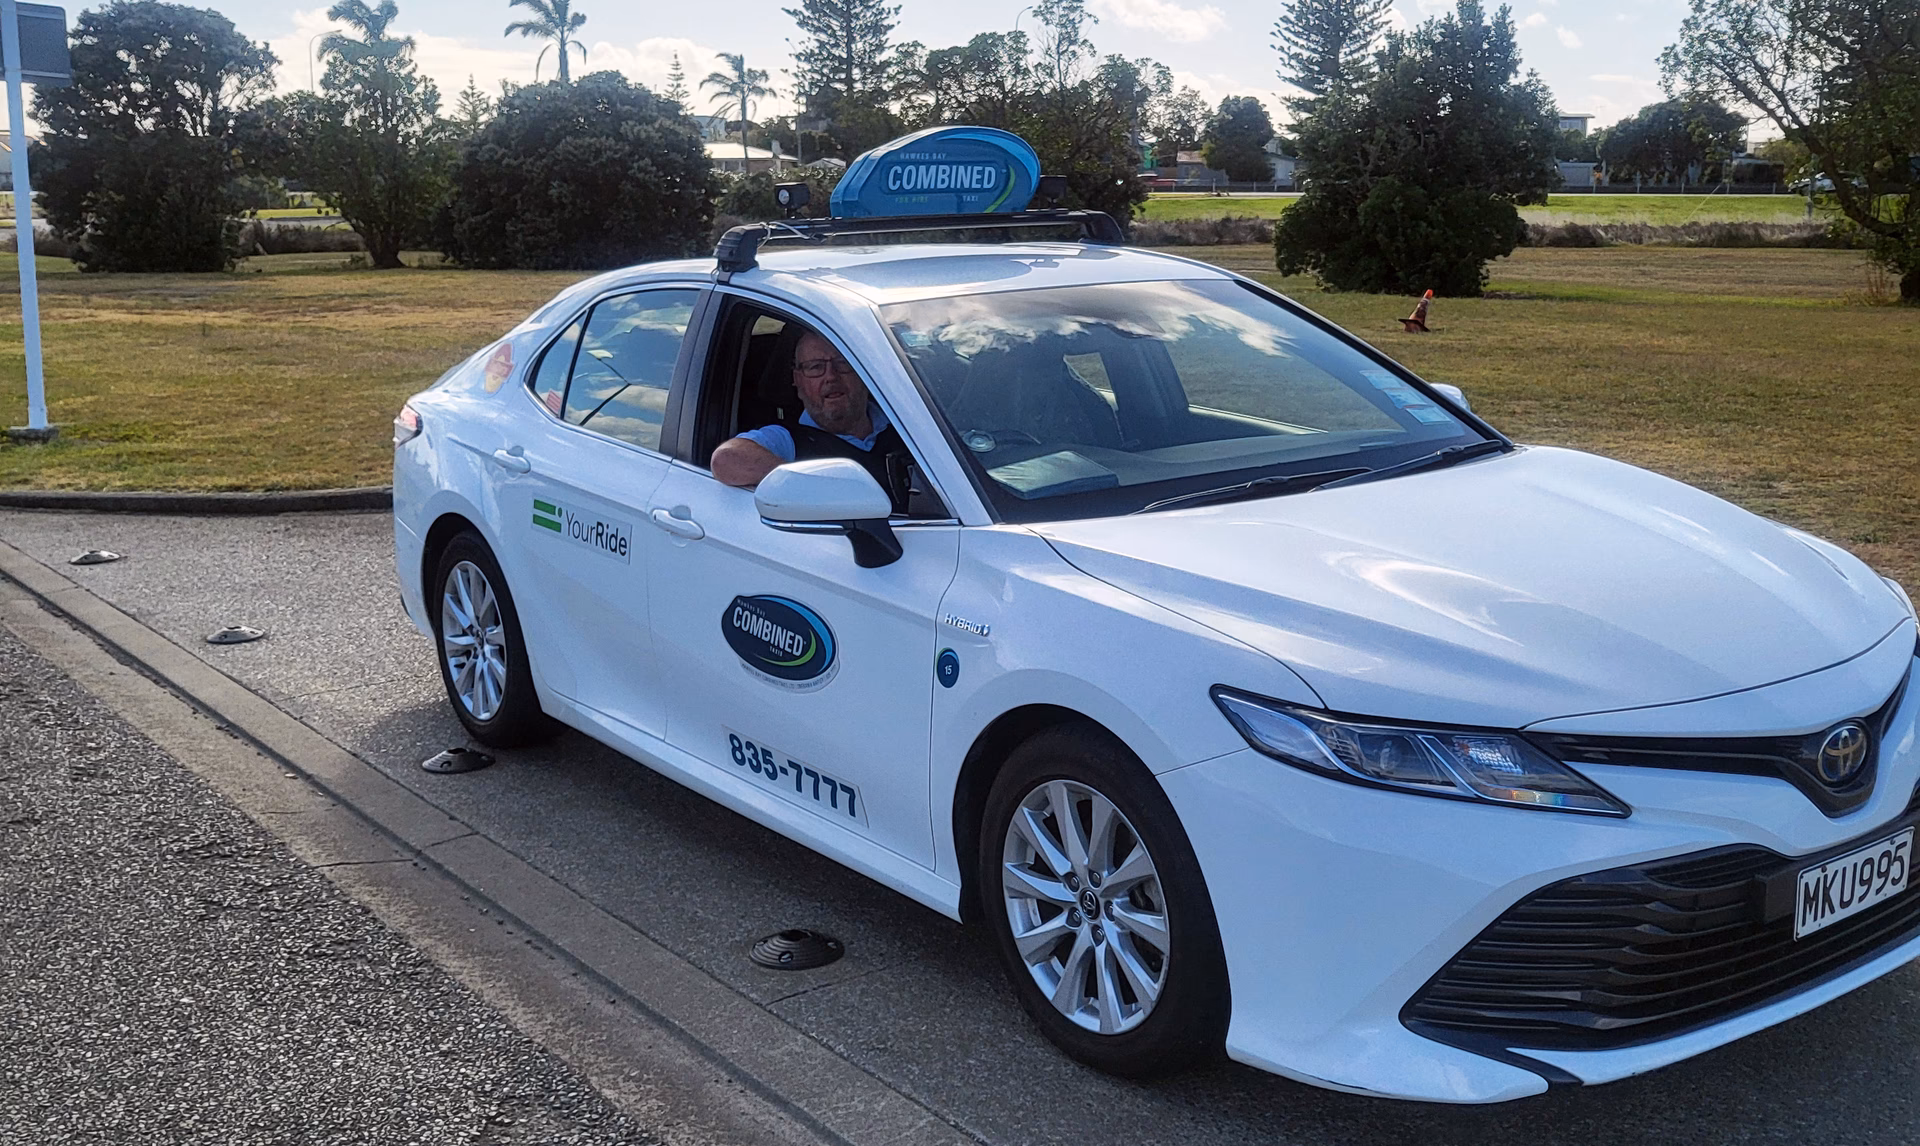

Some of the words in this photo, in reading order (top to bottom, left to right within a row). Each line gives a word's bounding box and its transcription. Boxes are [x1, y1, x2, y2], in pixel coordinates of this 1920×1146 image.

[932, 152, 947, 160] BAY
[888, 164, 997, 190] COMBINED
[962, 194, 979, 203] TAXI
[565, 509, 628, 557] YourRide
[732, 605, 804, 657] COMBINED
[943, 612, 983, 635] HYBRID
[943, 664, 953, 676] 15
[728, 732, 857, 818] 835-7777
[1800, 840, 1909, 928] MKU995
